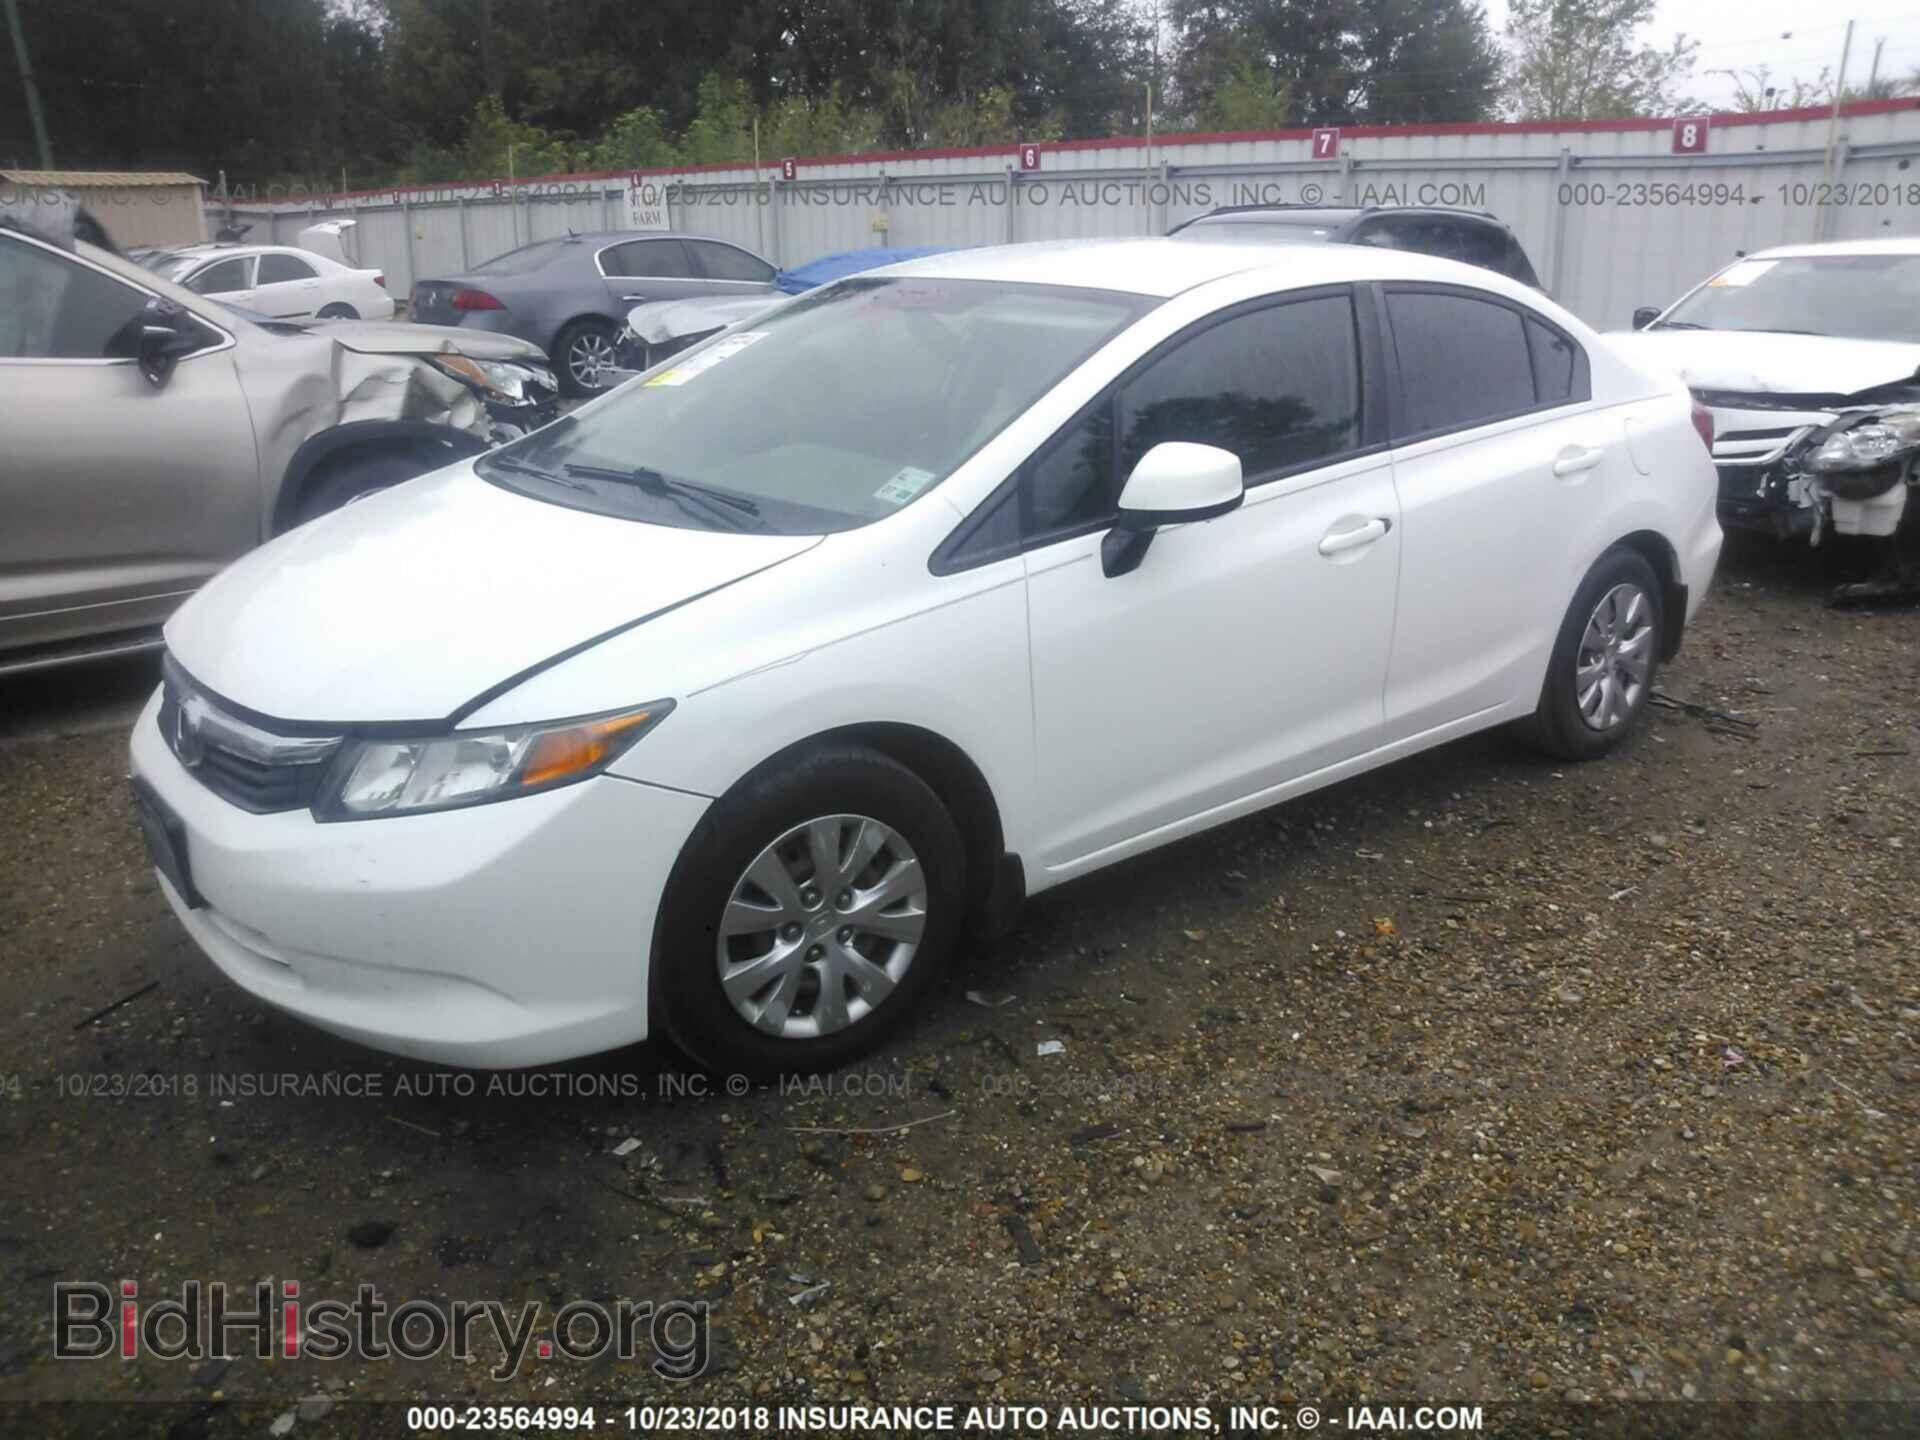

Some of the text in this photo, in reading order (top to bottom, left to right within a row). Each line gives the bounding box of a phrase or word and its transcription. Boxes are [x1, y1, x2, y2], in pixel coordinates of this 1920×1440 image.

[1320, 133, 1331, 153] 7
[1682, 124, 1697, 148] 8
[1026, 149, 1034, 167] 6
[786, 161, 792, 177] 5
[632, 211, 661, 224] FARM
